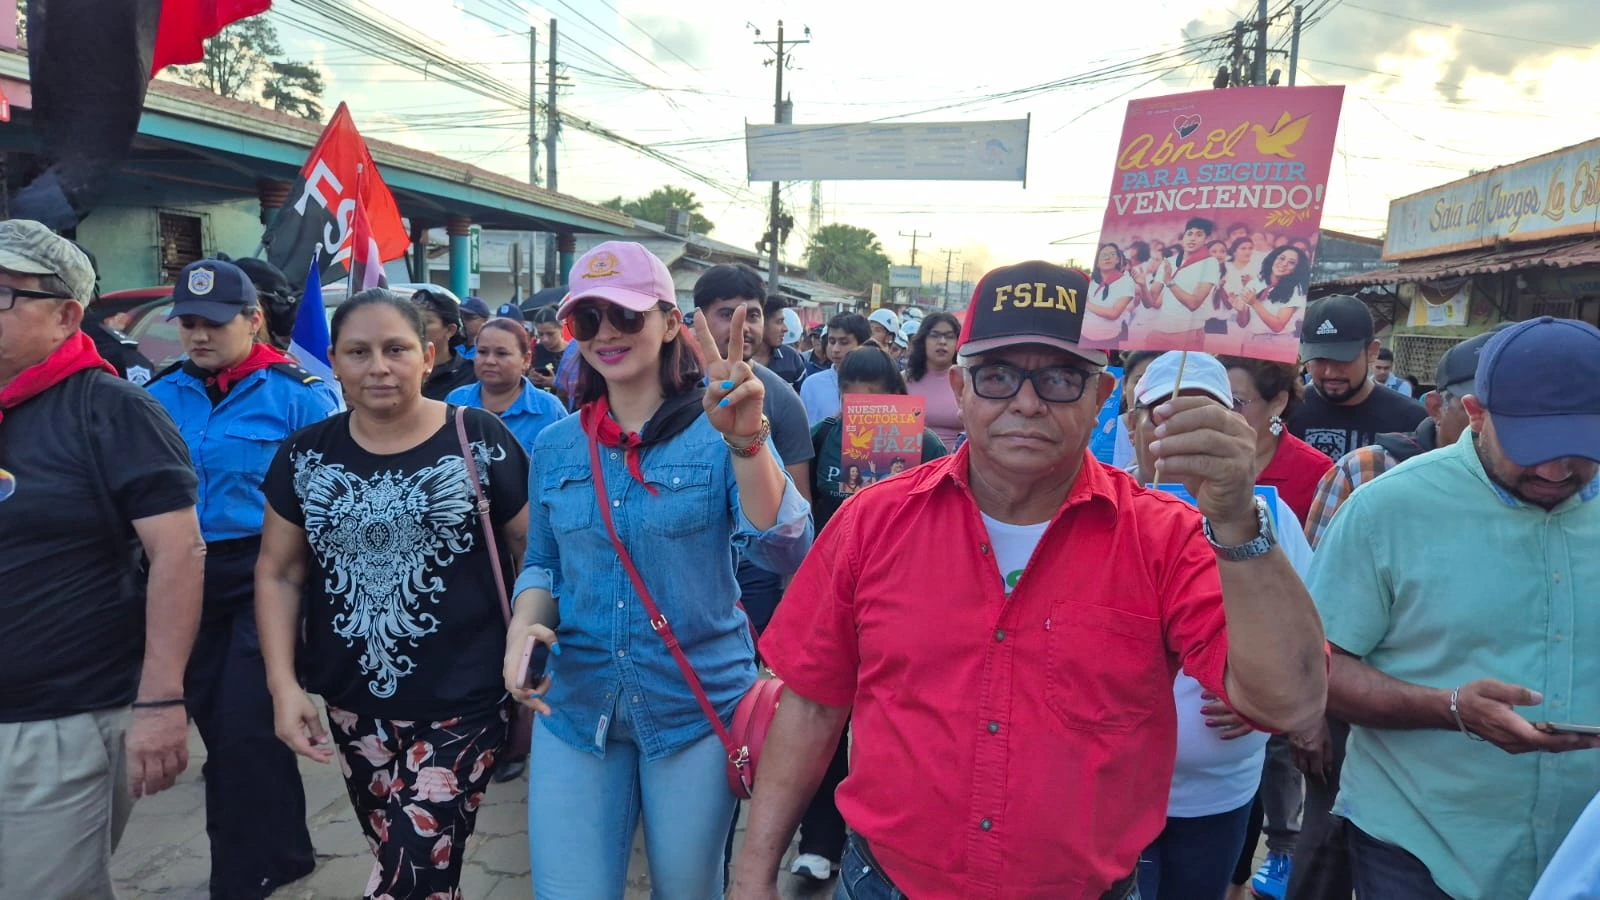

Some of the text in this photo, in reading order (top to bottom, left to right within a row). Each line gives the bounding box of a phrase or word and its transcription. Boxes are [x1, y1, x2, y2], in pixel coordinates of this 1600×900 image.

[1118, 121, 1250, 170] Abril
[1122, 161, 1307, 191] PARA SEGUIR
[1112, 184, 1324, 216] VENCIENDO!
[1429, 194, 1462, 233] Sala
[1467, 188, 1483, 226] de
[1487, 182, 1540, 233] Juegos
[1542, 167, 1566, 221] La
[992, 282, 1078, 314] FSLN
[847, 405, 898, 414] NUESTRA
[847, 413, 916, 425] VICTORIA
[872, 433, 924, 454] PAZ!
[877, 424, 900, 437] LA
